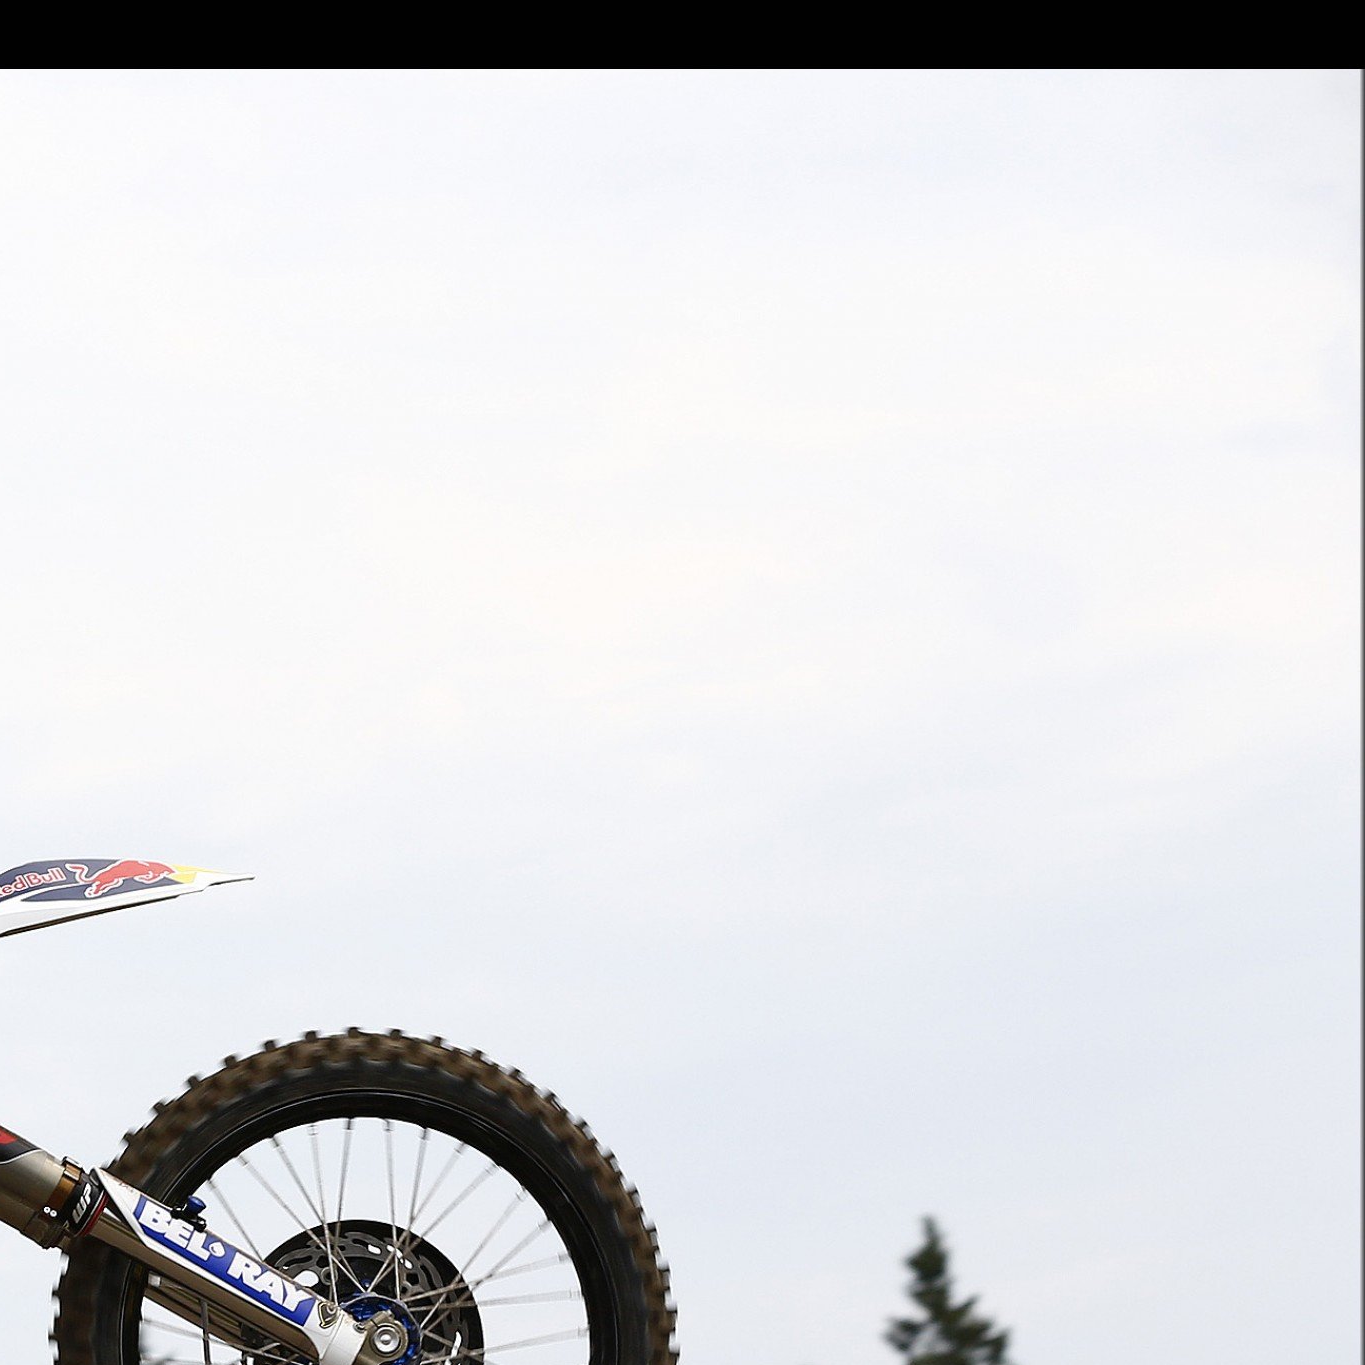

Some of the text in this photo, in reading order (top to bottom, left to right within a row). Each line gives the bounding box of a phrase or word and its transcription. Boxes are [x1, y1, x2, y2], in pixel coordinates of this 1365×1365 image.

[26, 867, 66, 889] Bull
[138, 1199, 315, 1313] BEL RAY
